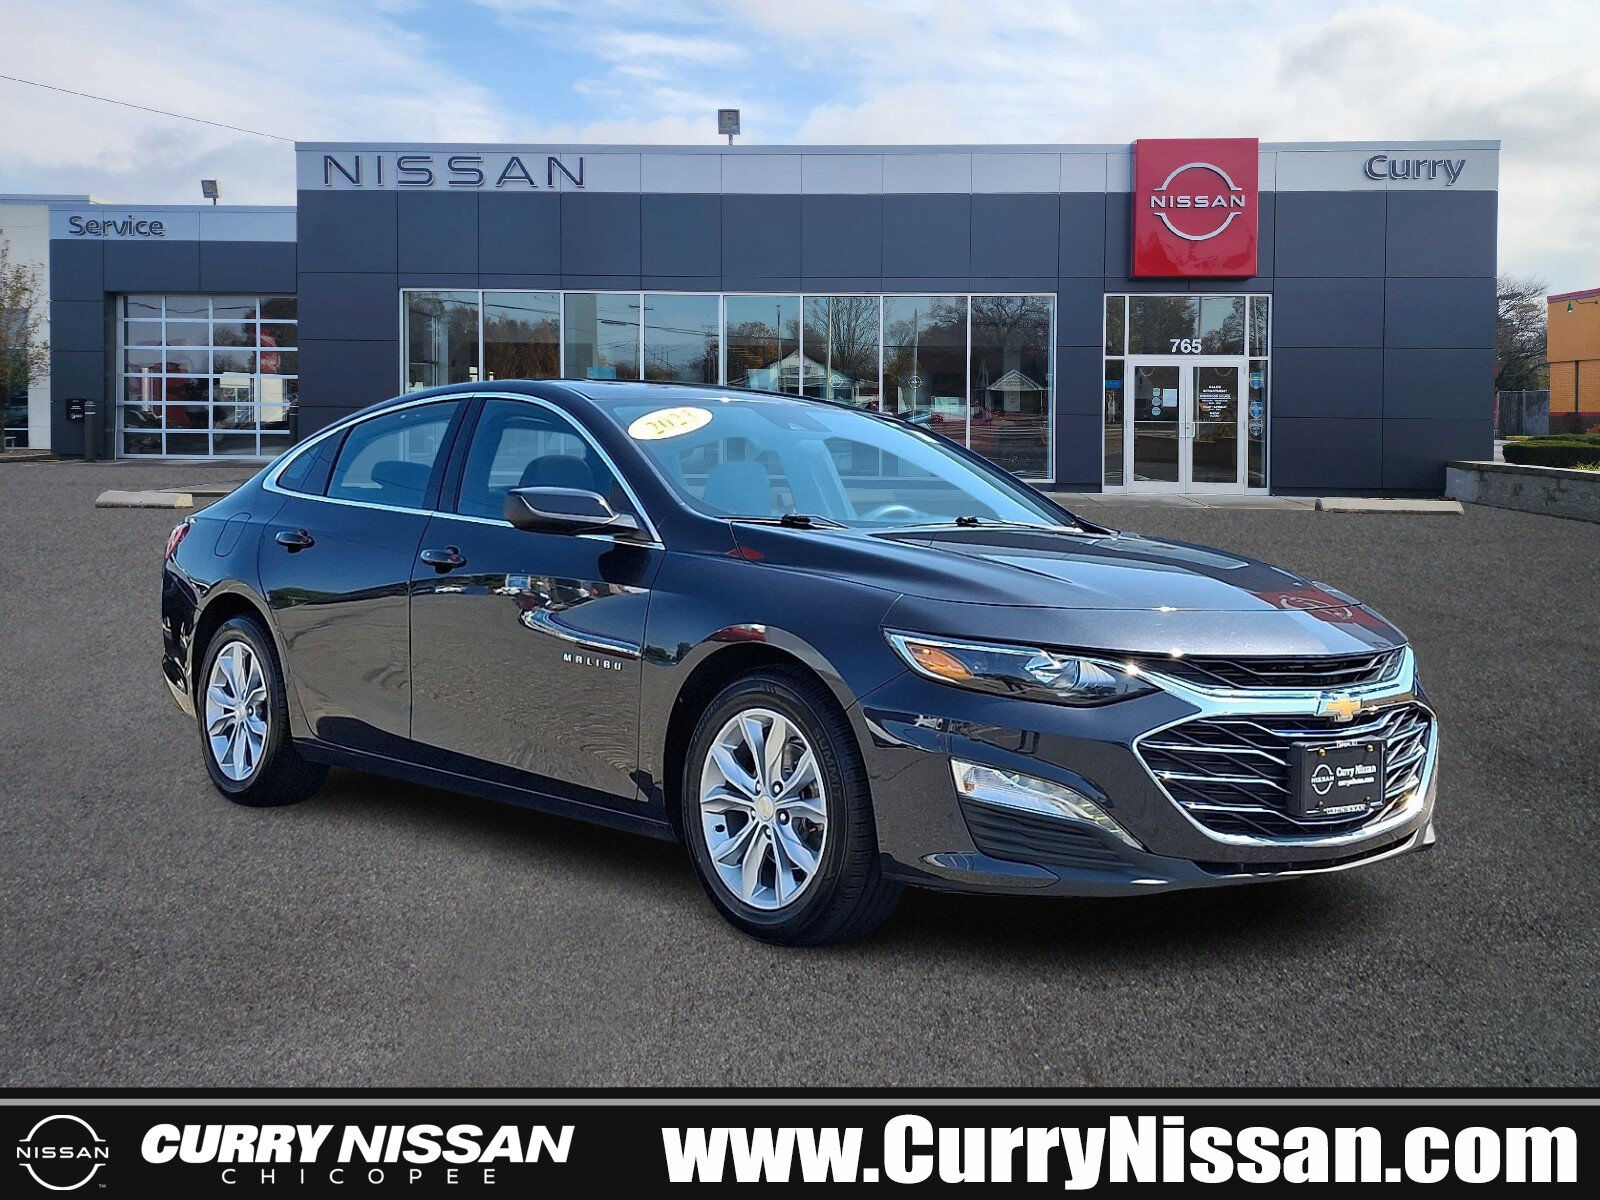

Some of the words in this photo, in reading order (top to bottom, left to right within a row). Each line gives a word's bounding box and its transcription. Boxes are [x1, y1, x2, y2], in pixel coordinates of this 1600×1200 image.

[323, 155, 586, 188] NISSAN
[1364, 154, 1467, 186] Curry
[1150, 194, 1246, 208] NISSAN
[69, 214, 166, 236] Service
[1170, 338, 1202, 354] 765
[563, 653, 622, 671] MALIBU
[1336, 766, 1355, 778] Curry
